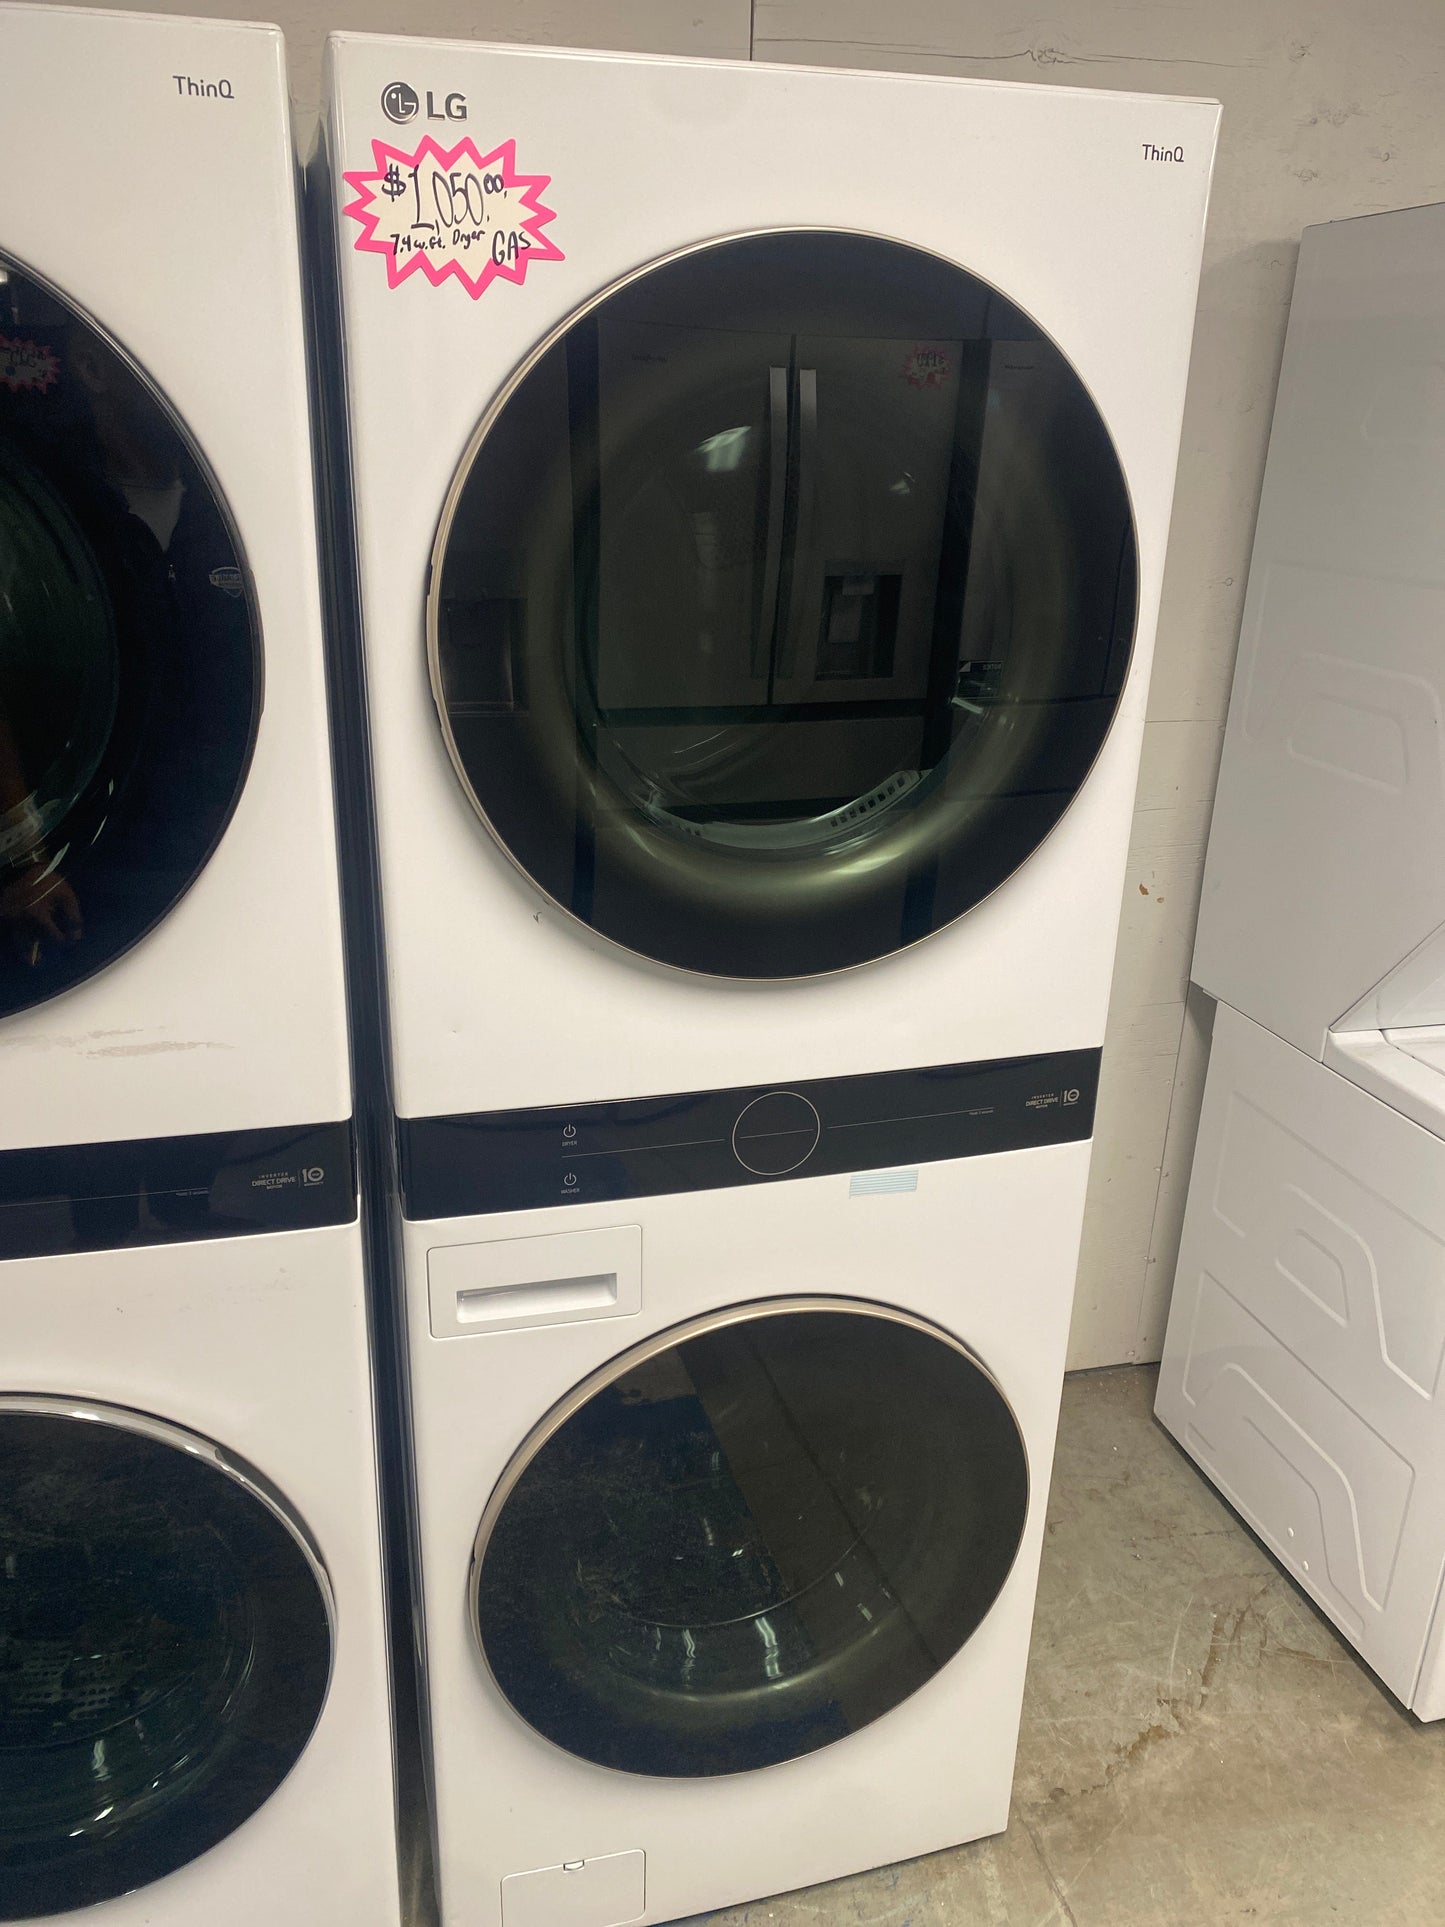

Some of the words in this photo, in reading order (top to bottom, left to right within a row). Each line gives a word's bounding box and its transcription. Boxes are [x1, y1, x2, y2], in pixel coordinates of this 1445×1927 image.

[172, 75, 235, 99] ThinQ
[426, 91, 468, 121] LG
[1142, 143, 1185, 163] ThinQ
[390, 233, 412, 256] 7.4
[452, 228, 486, 250] Dryer
[491, 230, 532, 266] GAS
[1063, 1088, 1080, 1103] 10
[251, 1179, 275, 1187] DIRECT
[276, 1176, 297, 1184] DRIVE
[302, 1166, 325, 1183] 10
